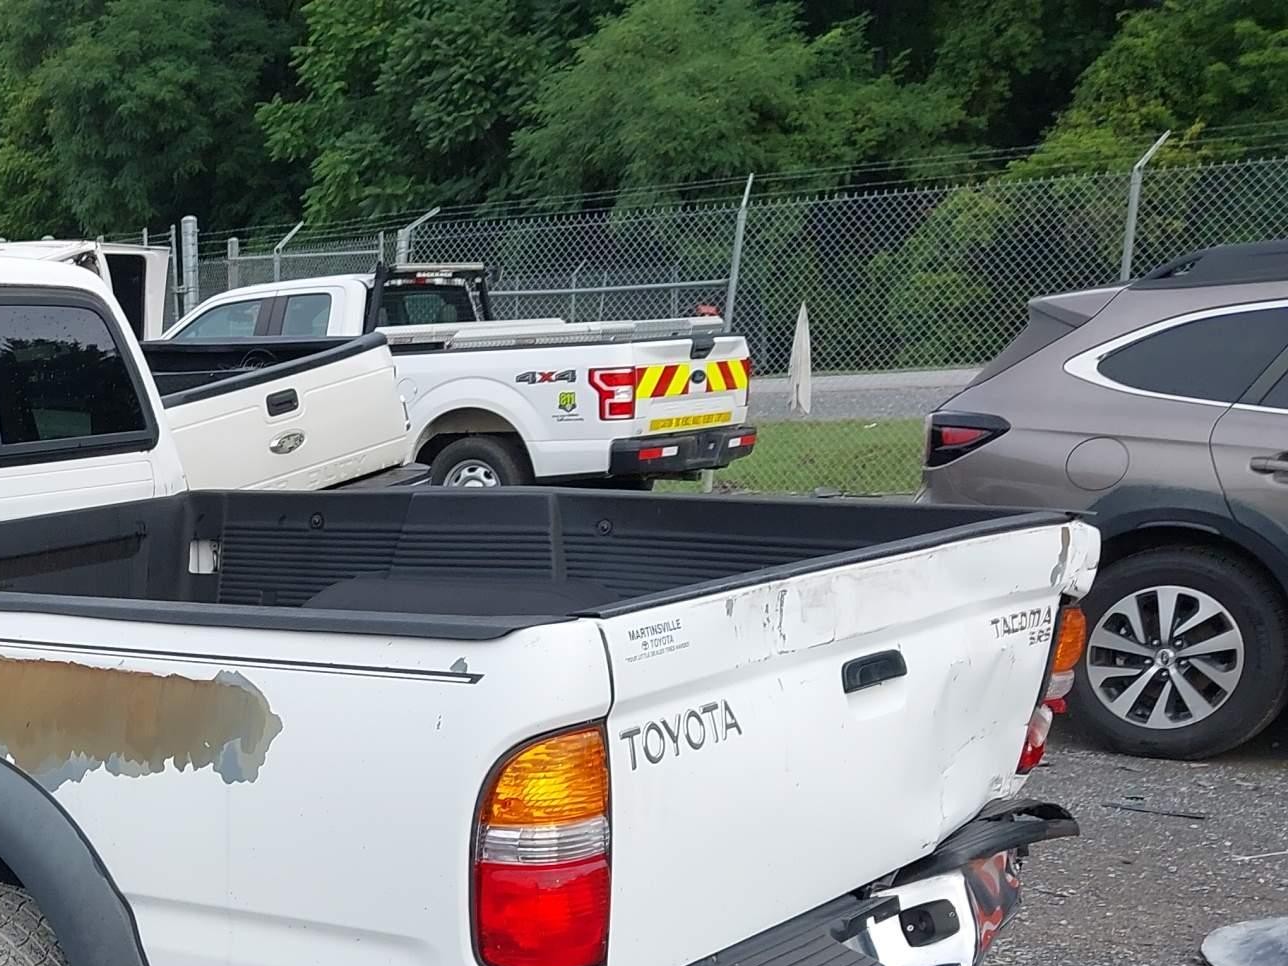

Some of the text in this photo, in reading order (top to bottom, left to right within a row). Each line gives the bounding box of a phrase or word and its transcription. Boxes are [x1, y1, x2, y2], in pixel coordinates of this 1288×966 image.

[627, 618, 682, 641] MARTINSVILLE
[990, 605, 1052, 639] TACOMA
[650, 635, 675, 649] TOYOTA
[619, 699, 743, 771] TOYOTA
